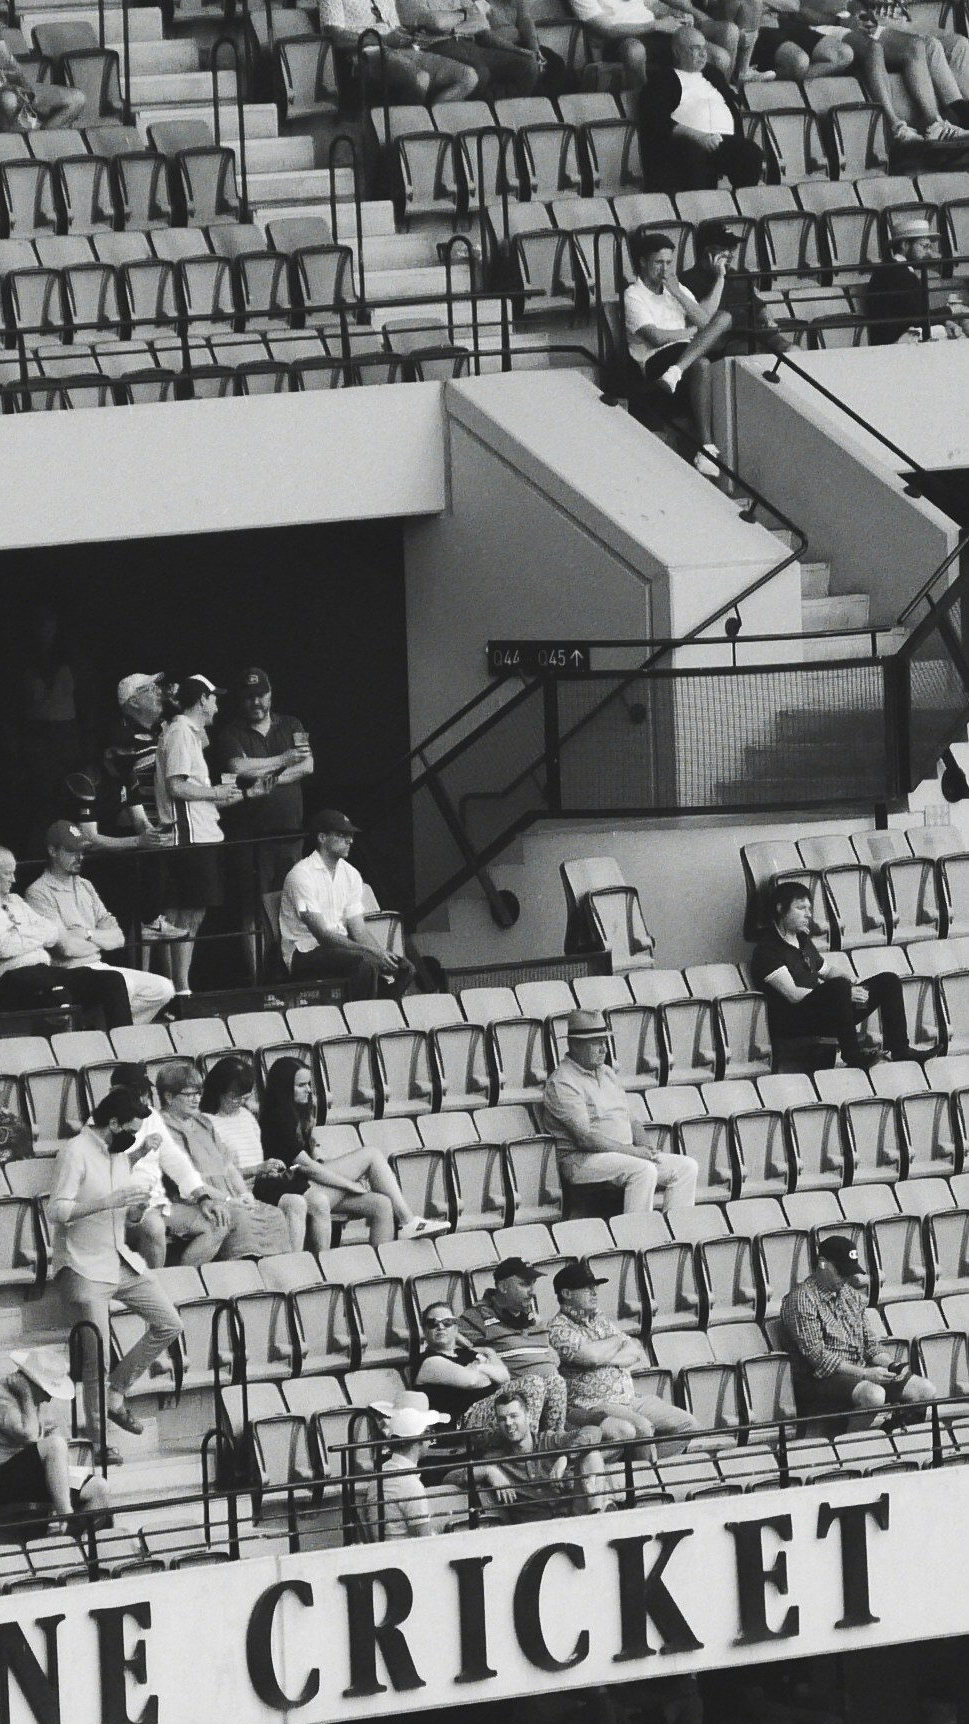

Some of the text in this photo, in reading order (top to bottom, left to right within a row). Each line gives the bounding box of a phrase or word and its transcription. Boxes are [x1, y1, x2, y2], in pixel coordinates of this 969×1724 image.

[493, 649, 566, 666] Q44 Q45
[245, 1492, 890, 1714] CRICKET
